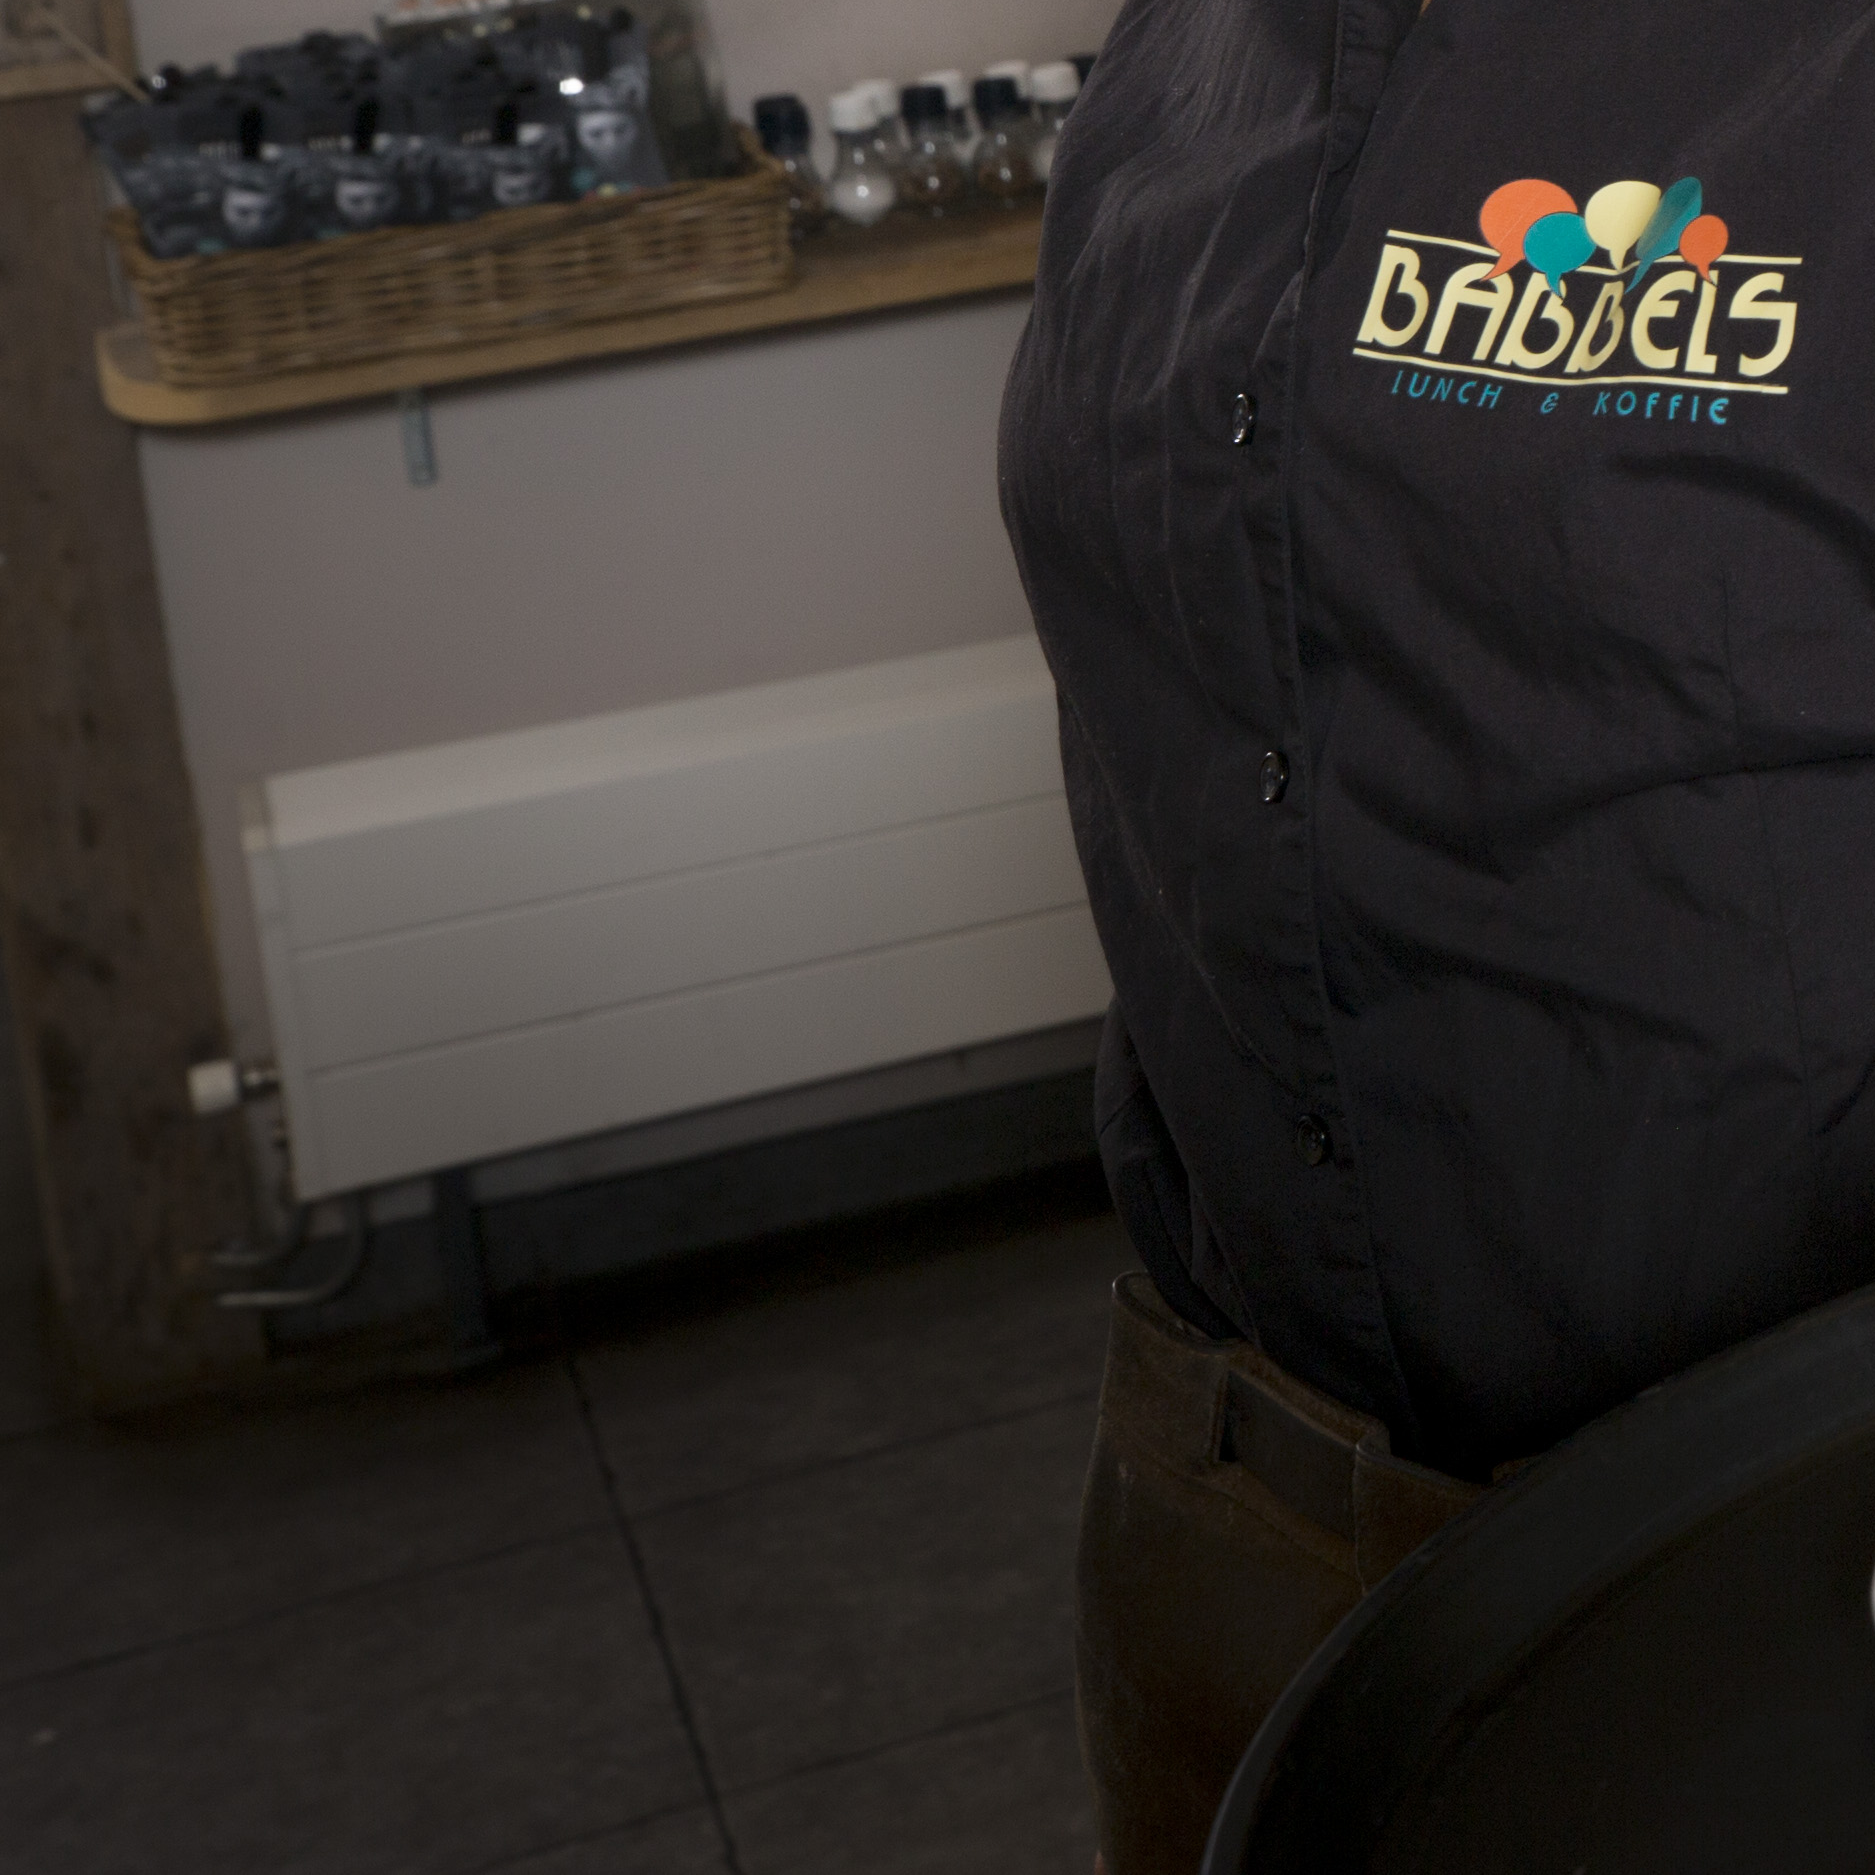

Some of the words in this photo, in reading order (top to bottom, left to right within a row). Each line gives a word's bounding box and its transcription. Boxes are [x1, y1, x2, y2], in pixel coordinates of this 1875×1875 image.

[1355, 242, 1799, 378] BABBELS
[1391, 369, 1503, 411] LUNCH
[1540, 392, 1560, 415] &
[1593, 390, 1730, 425] KOFFIE
